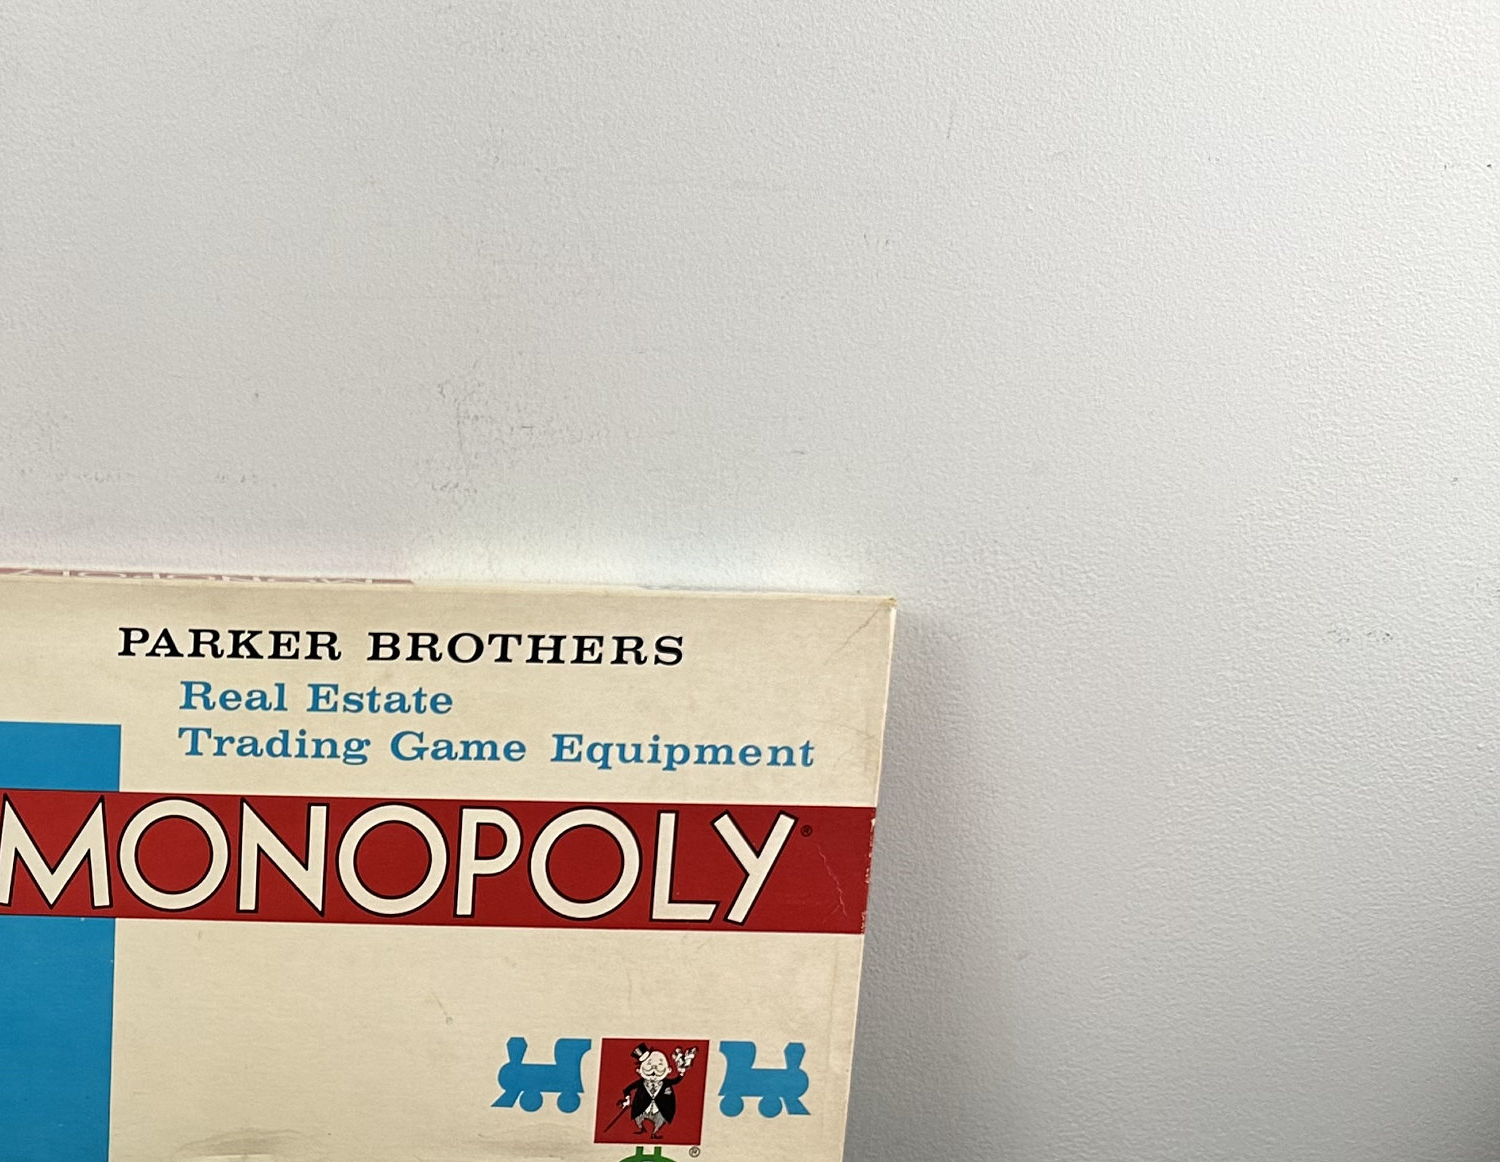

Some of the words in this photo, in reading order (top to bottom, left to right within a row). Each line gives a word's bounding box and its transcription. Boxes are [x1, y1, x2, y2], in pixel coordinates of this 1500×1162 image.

[118, 628, 341, 660] PARKER
[367, 632, 683, 665] BROTHERS
[179, 681, 288, 711] Real
[307, 684, 452, 714] Estate
[178, 728, 370, 765] Trading
[391, 731, 526, 761] Game
[550, 734, 814, 771] Equipment
